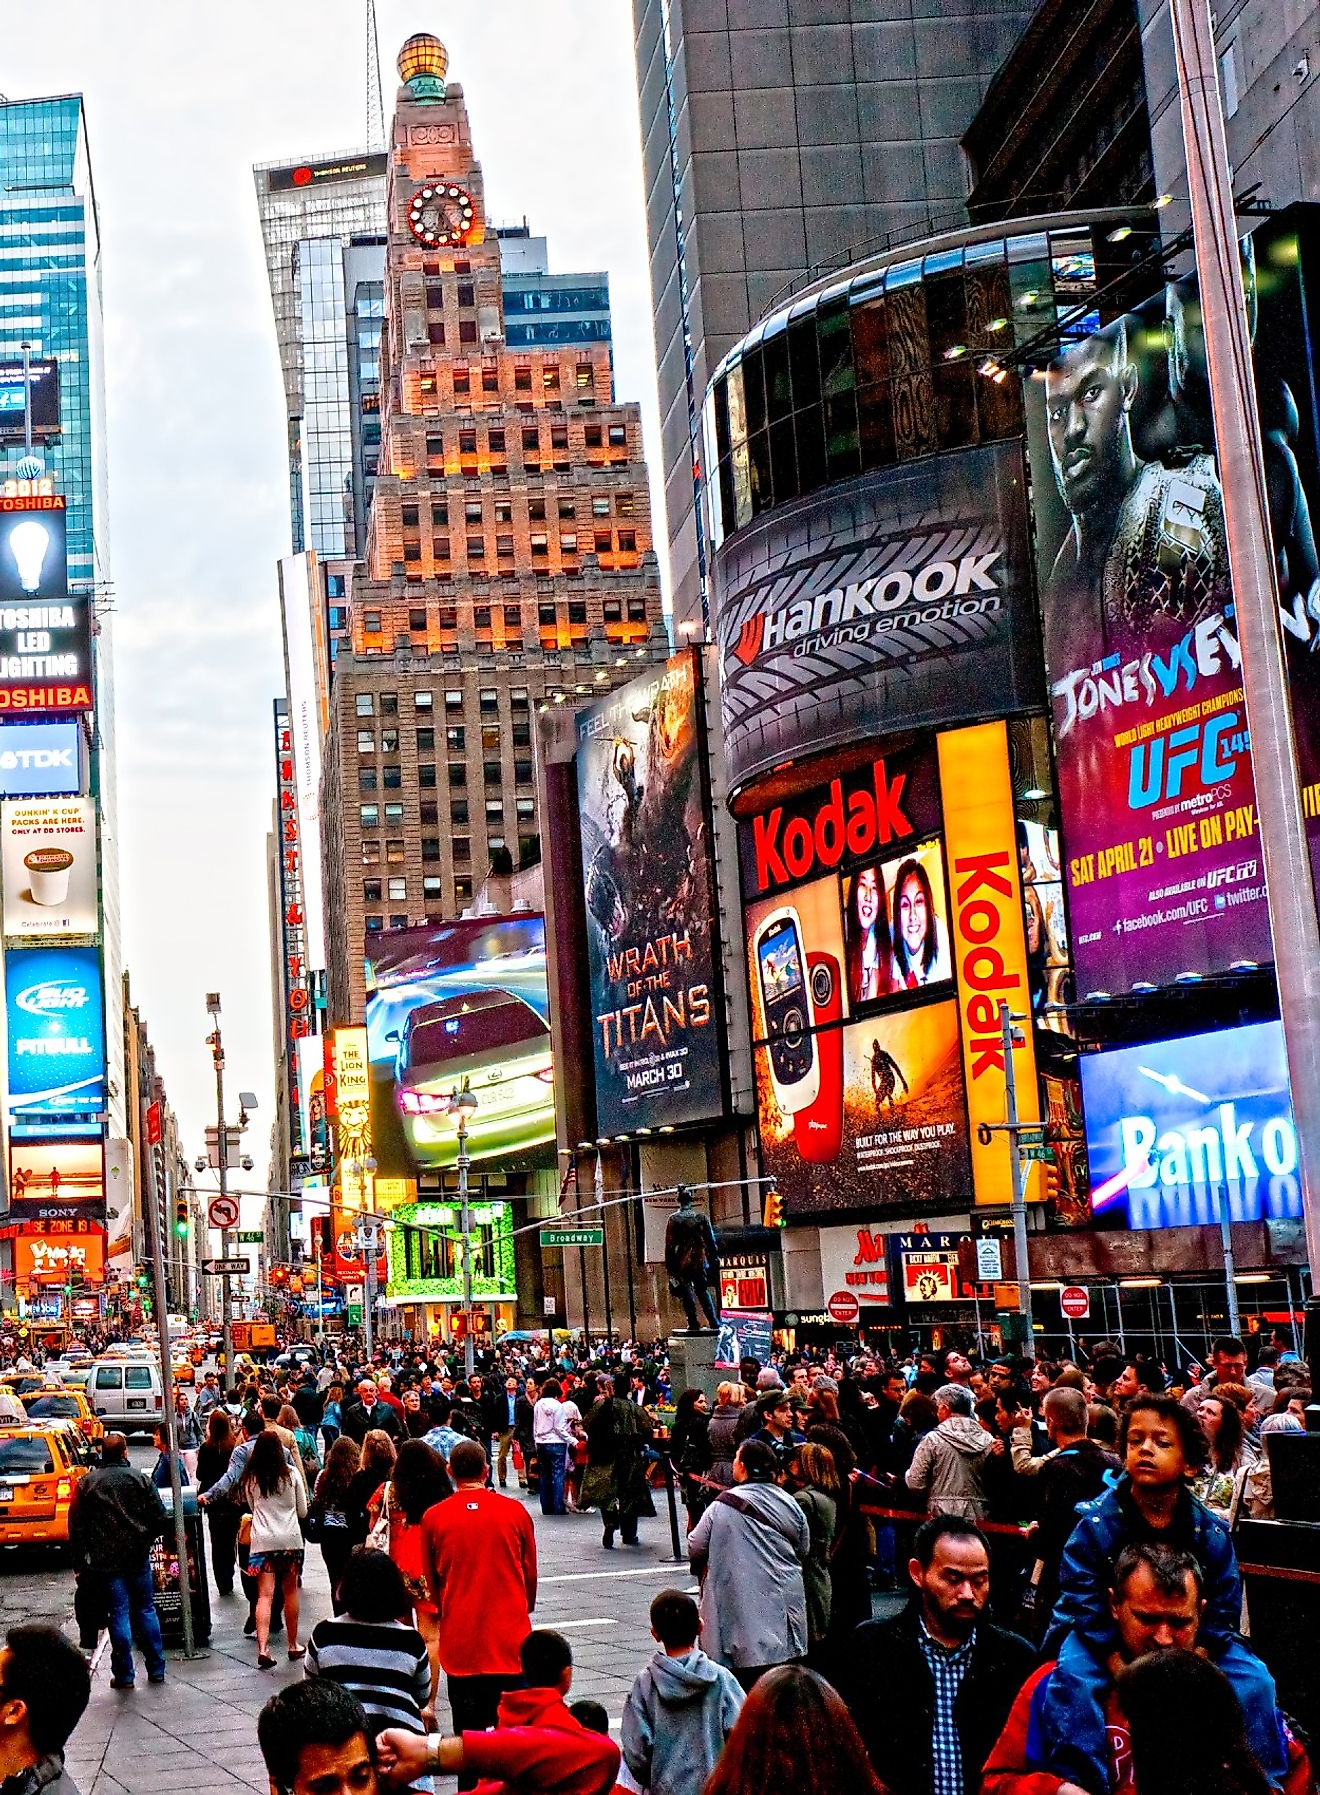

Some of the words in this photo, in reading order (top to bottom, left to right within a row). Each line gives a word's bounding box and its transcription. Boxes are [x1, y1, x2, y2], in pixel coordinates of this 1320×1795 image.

[4, 480, 52, 496] 2012
[793, 620, 871, 660] driving
[875, 594, 1001, 633] emotion
[17, 632, 50, 653] LED
[1053, 652, 1155, 740] JONES
[1152, 631, 1197, 699] VS
[1114, 728, 1138, 748] WORLD
[1138, 722, 1155, 741] LIGHT
[1155, 707, 1201, 733] HEAVYWEIGHT
[17, 748, 72, 767] TDK
[1127, 711, 1238, 810] UFC
[1180, 783, 1232, 812] metroPCS
[752, 759, 916, 892] Kodak
[1071, 856, 1095, 887] SAT
[1096, 845, 1138, 880] APRIL
[1139, 836, 1155, 867] 21
[1165, 821, 1198, 859] LIVE
[1200, 815, 1224, 847] ON
[606, 930, 693, 984] WRATH
[954, 850, 1028, 1080] Kodak
[596, 984, 711, 1060] TITANS
[342, 1050, 359, 1059] THE
[340, 1060, 363, 1071] LION
[626, 1068, 665, 1090] MARCH
[666, 1062, 683, 1080] 30
[339, 1073, 366, 1088] KING
[855, 1135, 874, 1149] BUILT
[874, 1133, 888, 1145] FOR
[888, 1131, 902, 1143] THE
[902, 1128, 919, 1141] WAY
[919, 1126, 936, 1139] YOU
[936, 1122, 956, 1136] PLAY.
[1036, 1150, 1045, 1159] 46
[38, 1208, 78, 1217] SONY
[50, 1220, 74, 1232] ZONE
[78, 1220, 88, 1232] IS
[239, 1233, 245, 1242] W
[246, 1232, 255, 1241] 46
[549, 1233, 594, 1243] Broadway
[231, 1262, 245, 1270] WAY
[719, 1254, 767, 1268] MARQUIS
